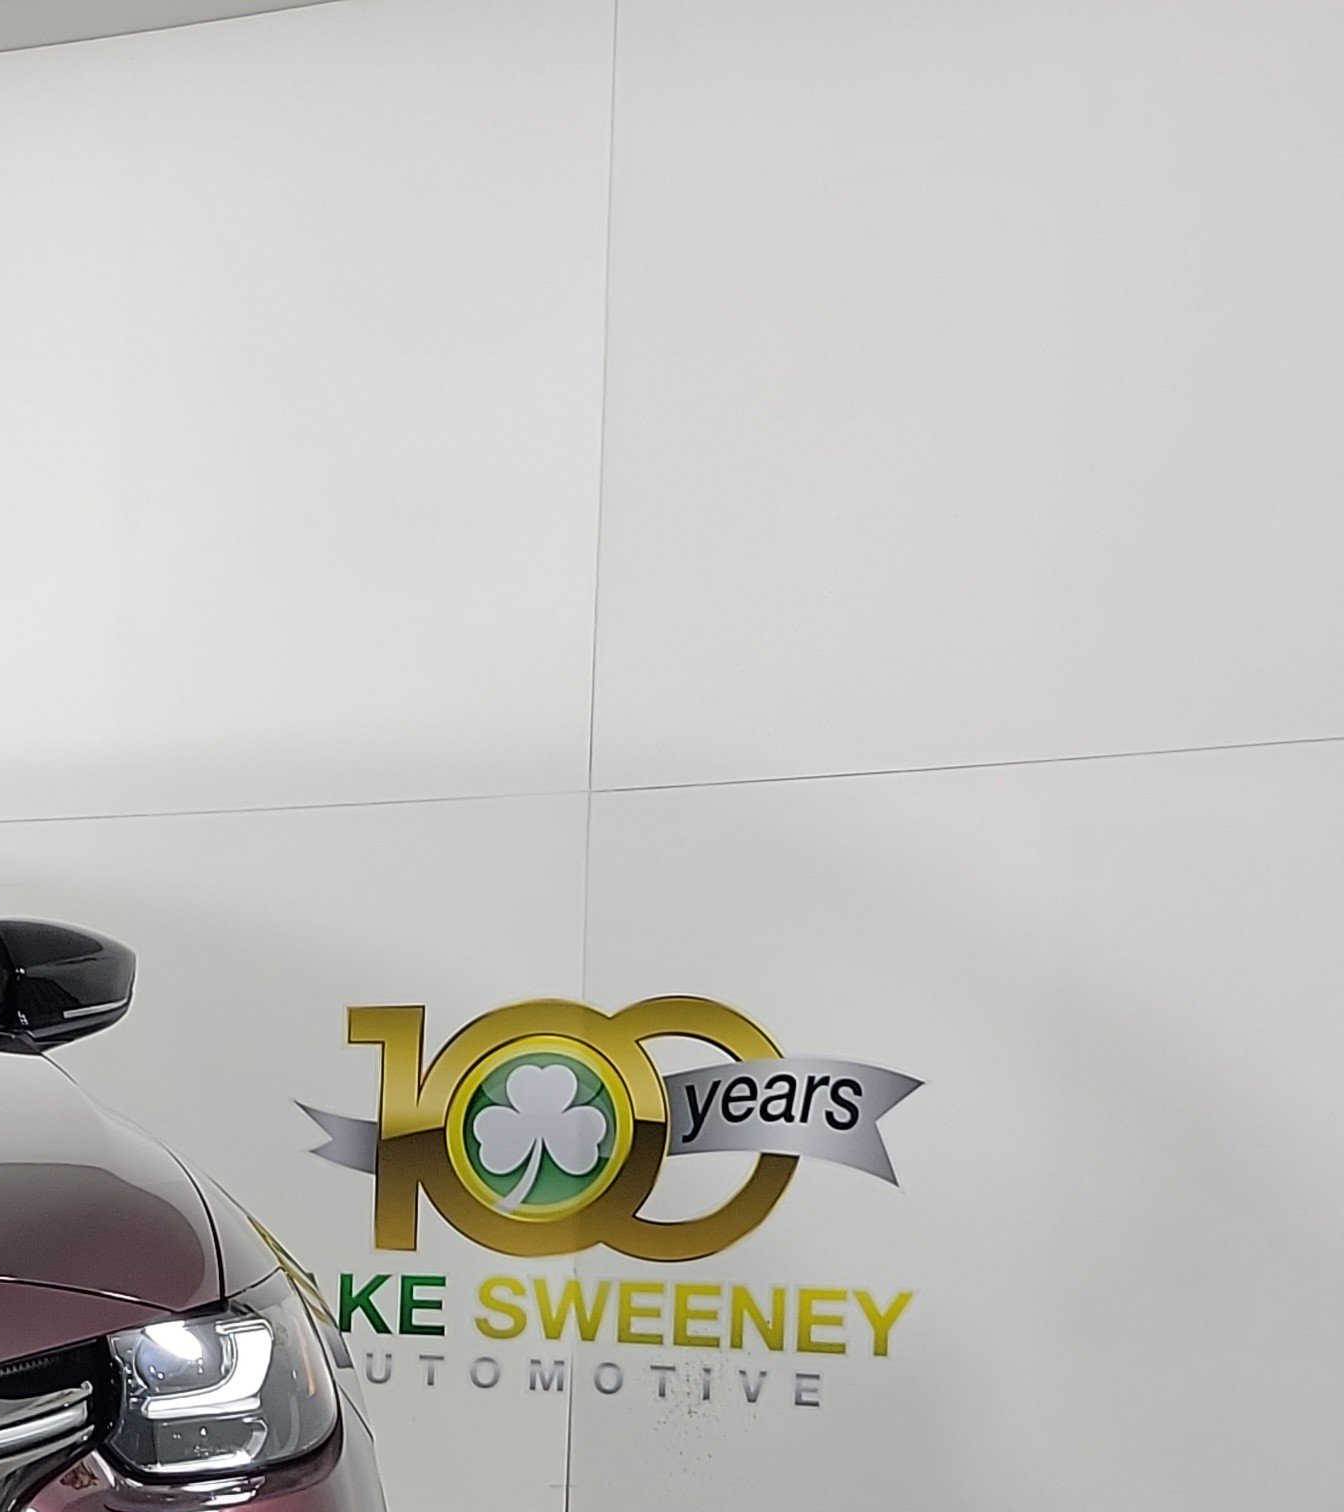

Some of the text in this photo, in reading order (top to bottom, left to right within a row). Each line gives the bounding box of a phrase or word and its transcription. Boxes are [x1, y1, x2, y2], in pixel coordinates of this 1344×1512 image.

[347, 995, 864, 1262] 100 years
[336, 1272, 914, 1359] KE SWEENEY
[365, 1352, 822, 1408] UTOMOTIVE
